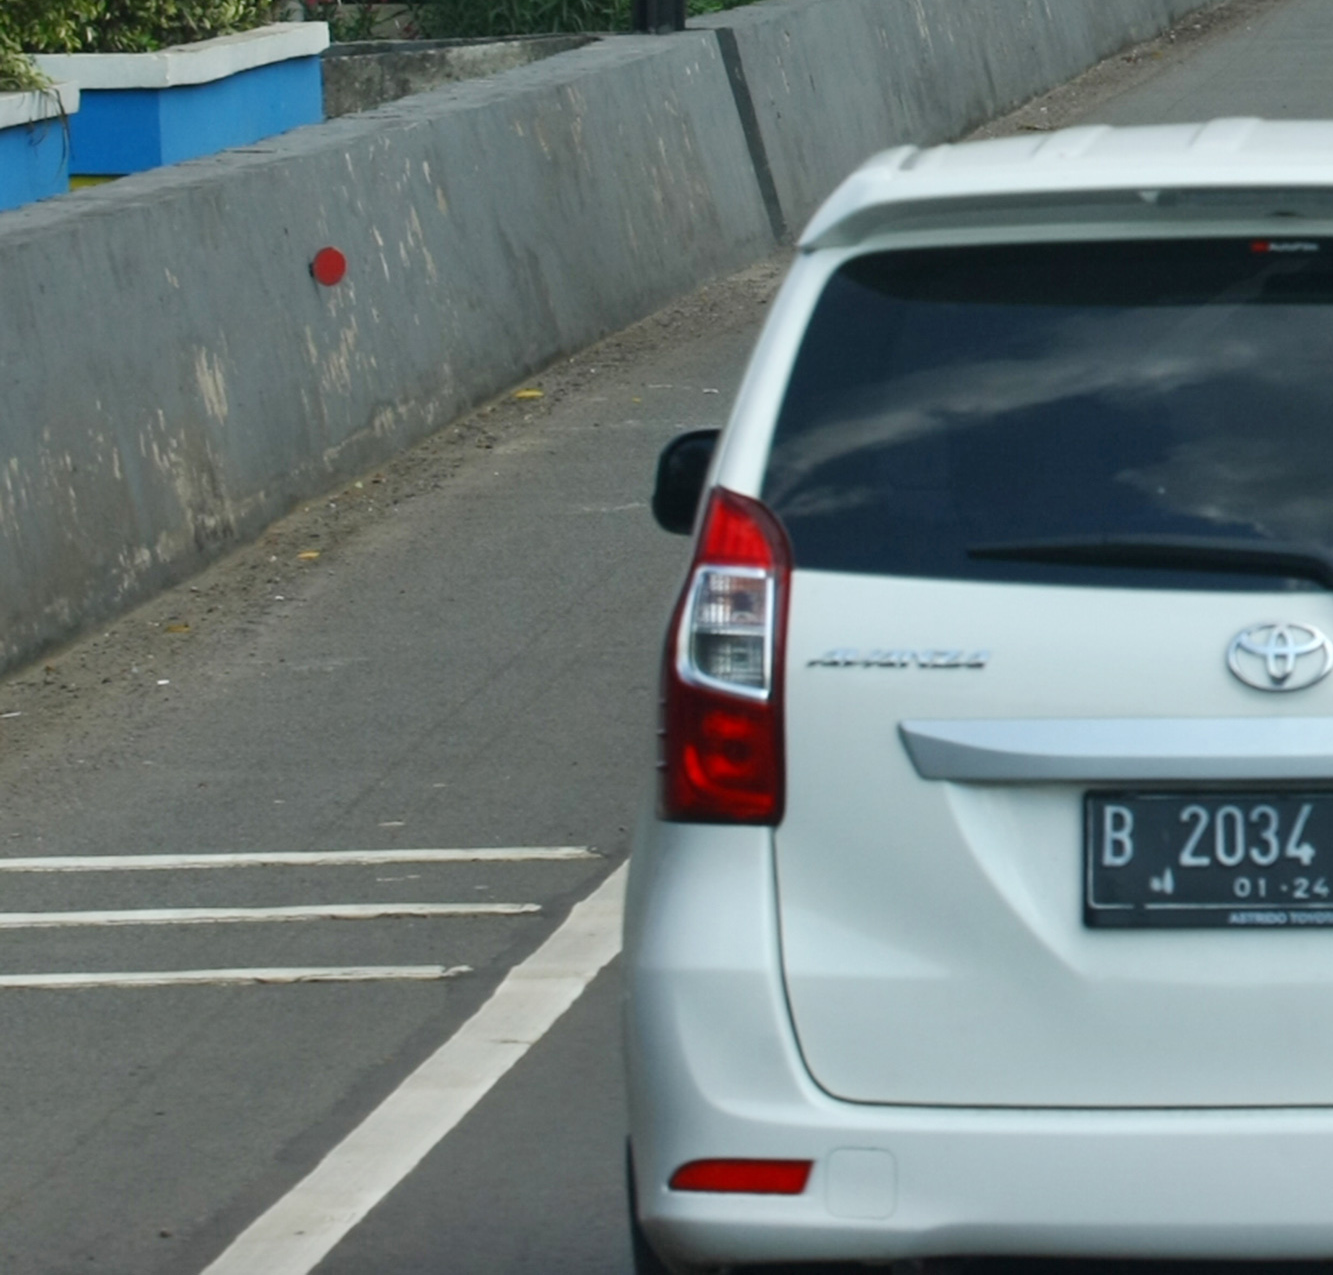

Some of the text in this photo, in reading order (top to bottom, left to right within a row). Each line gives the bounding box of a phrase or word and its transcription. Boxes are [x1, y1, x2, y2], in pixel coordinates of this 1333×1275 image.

[1102, 805, 1134, 867] B
[1178, 804, 1316, 867] 2034
[1228, 911, 1287, 924] ASTRIDO
